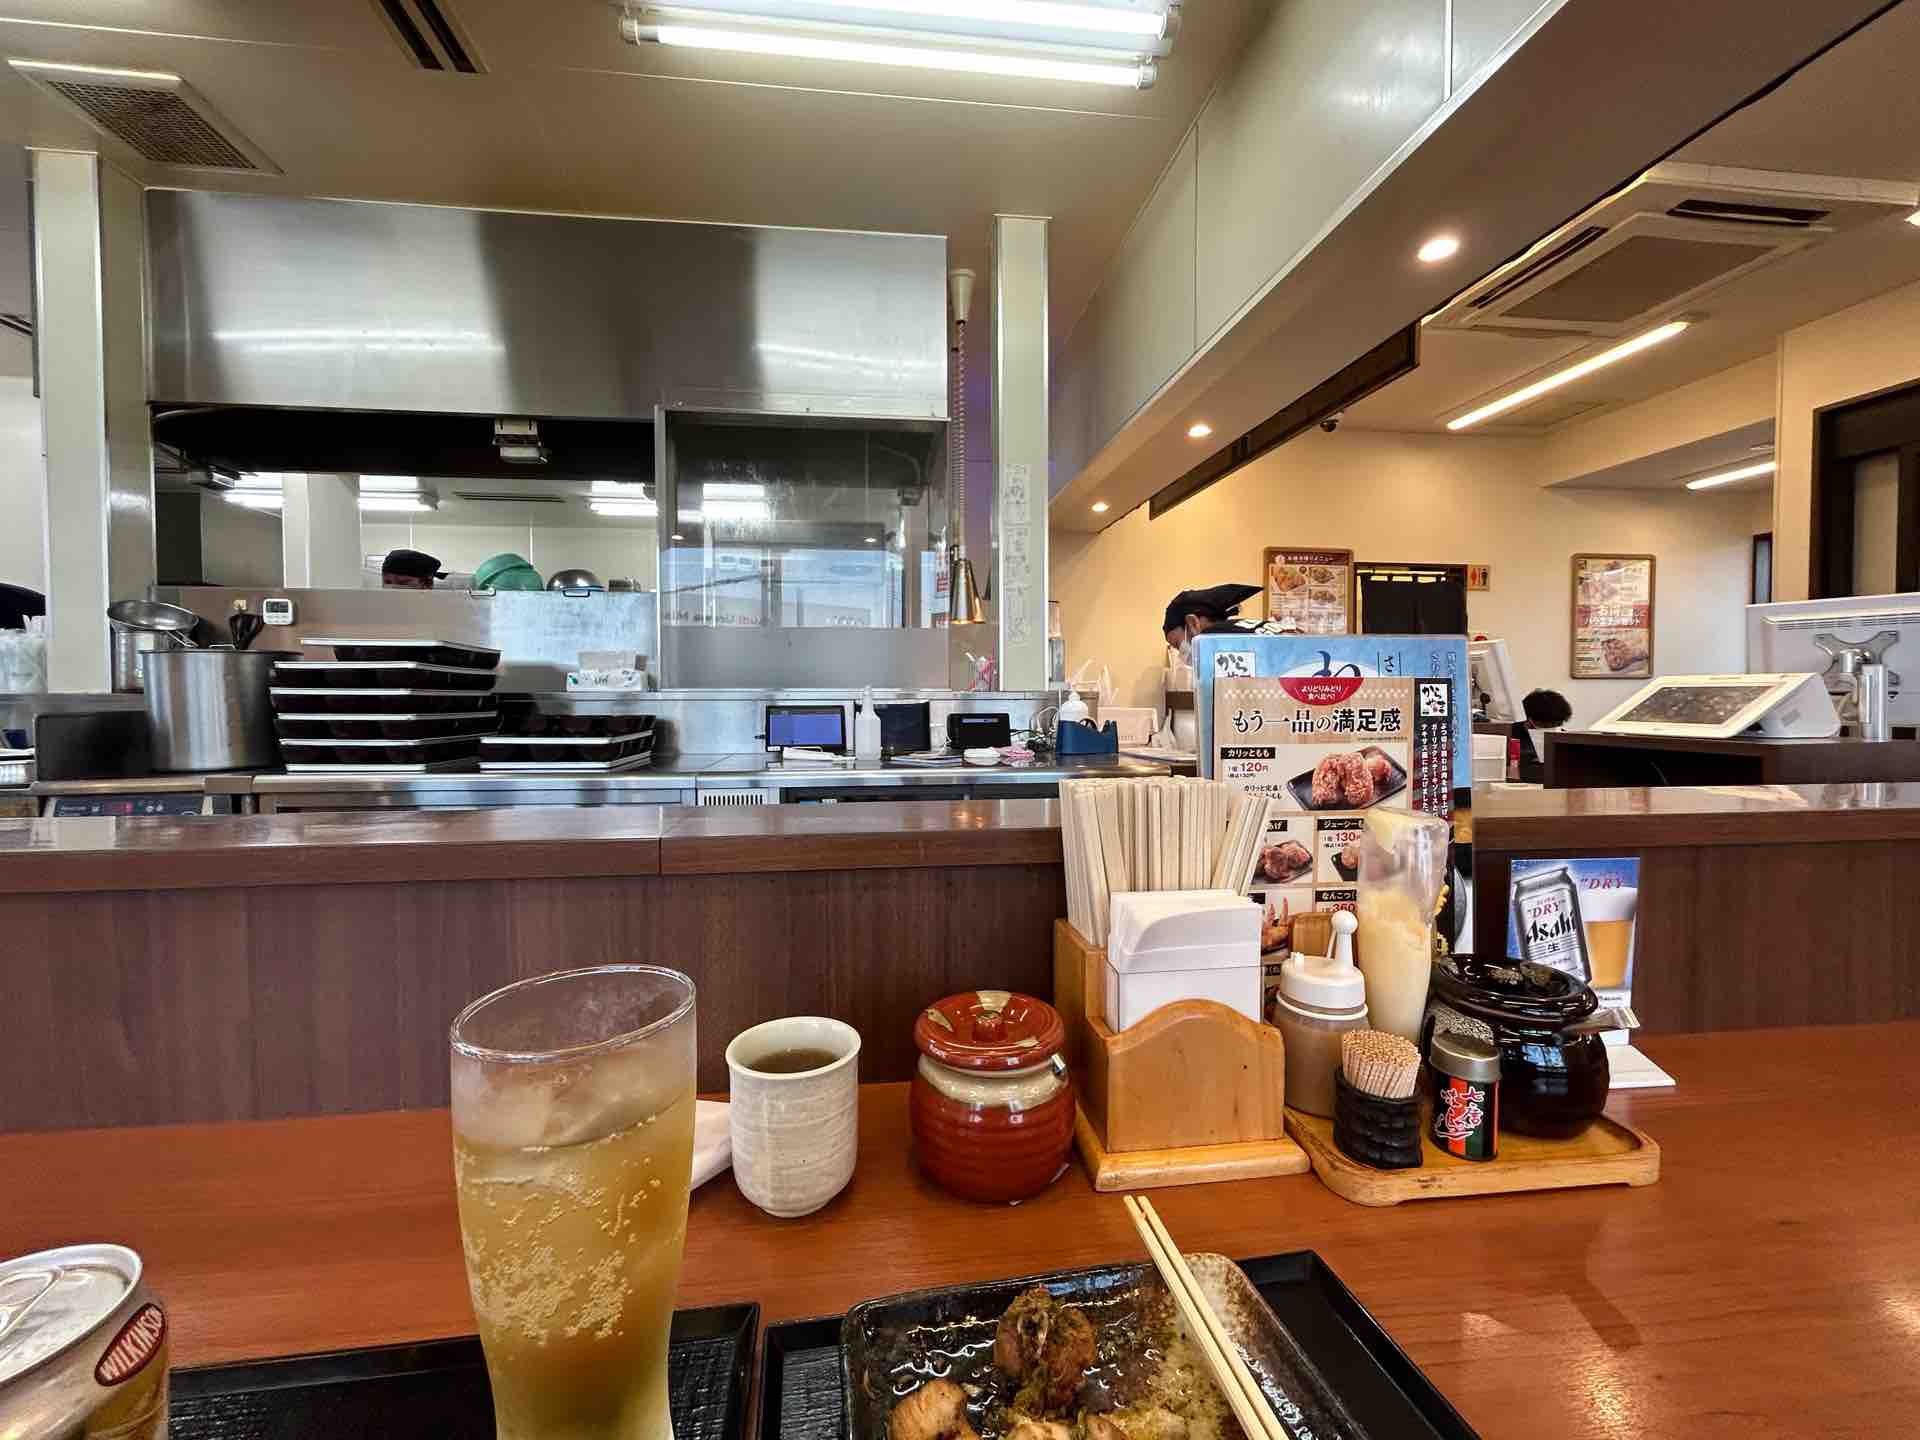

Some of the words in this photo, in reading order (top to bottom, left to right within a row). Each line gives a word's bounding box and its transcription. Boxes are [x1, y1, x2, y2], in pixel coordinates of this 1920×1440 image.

[1233, 709, 1401, 733] もう一品の満足感
[1527, 910, 1577, 944] Asahi
[1547, 942, 1561, 953] 生
